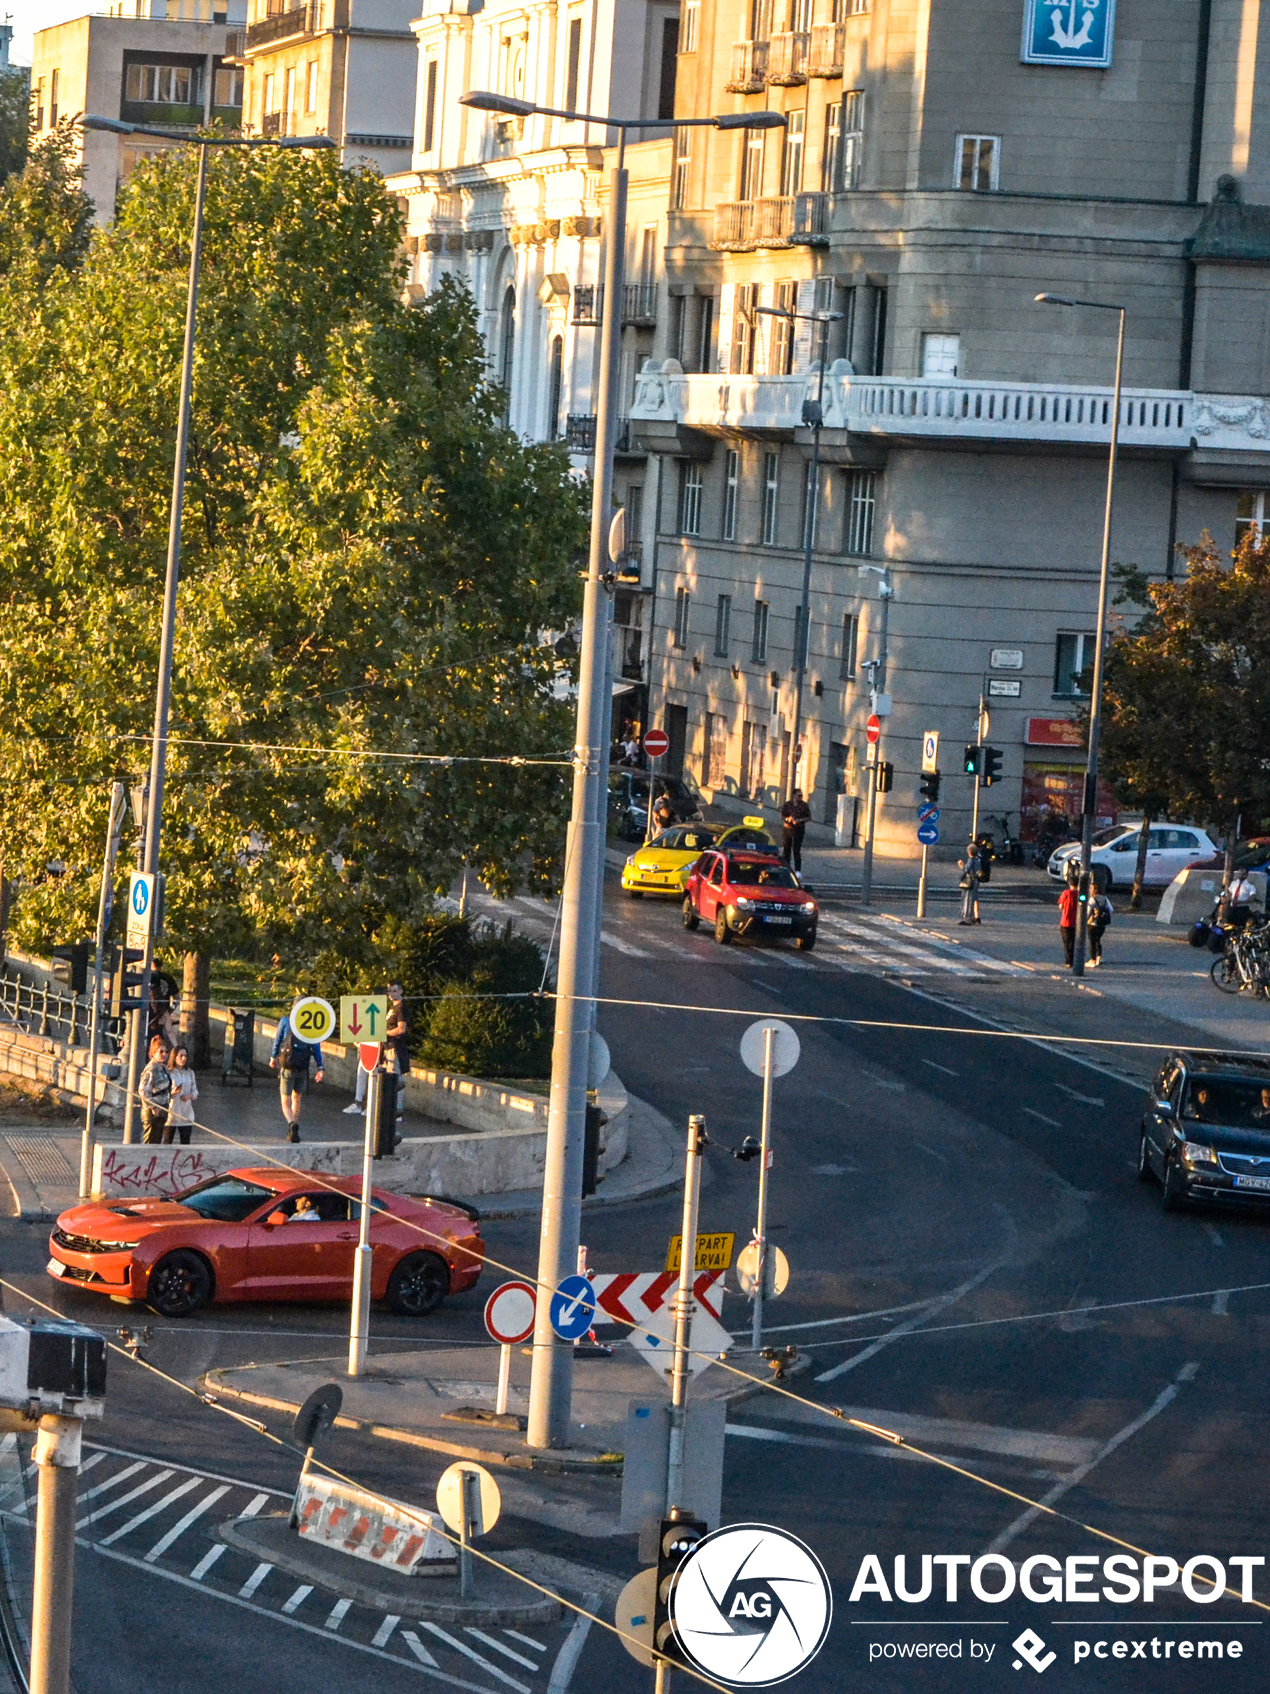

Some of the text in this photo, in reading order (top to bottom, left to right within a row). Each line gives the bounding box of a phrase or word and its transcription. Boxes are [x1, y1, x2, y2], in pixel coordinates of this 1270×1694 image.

[300, 1010, 325, 1030] 20
[1239, 1177, 1270, 1189] MGY-42
[676, 1236, 728, 1251] RPART
[673, 1252, 726, 1267] LÁRVA!
